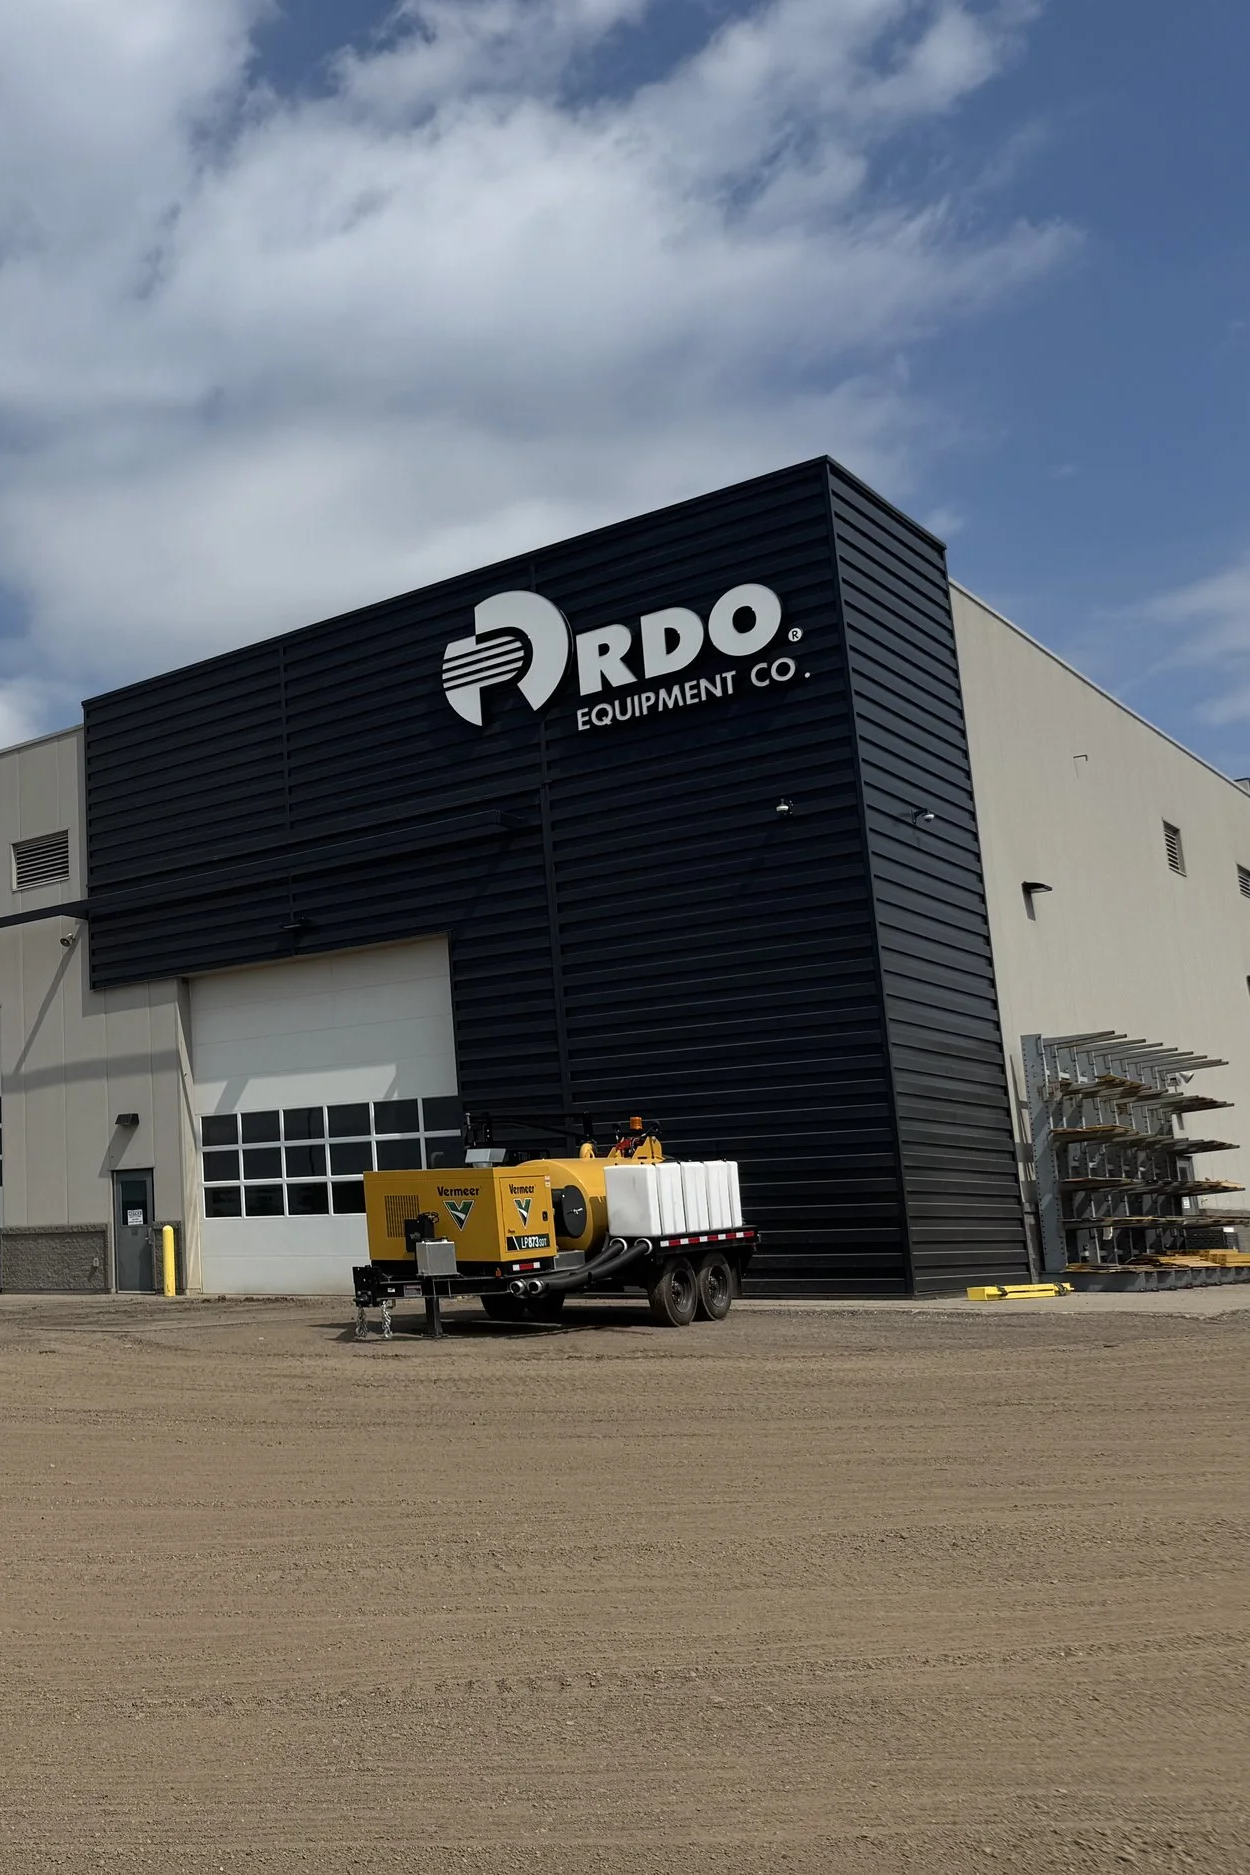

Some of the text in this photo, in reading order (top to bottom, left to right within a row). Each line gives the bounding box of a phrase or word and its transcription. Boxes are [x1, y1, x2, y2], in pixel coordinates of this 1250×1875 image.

[576, 657, 811, 731] EQUIPMENT CO.
[437, 1186, 480, 1197] Vermeer
[508, 1184, 535, 1195] Vermeer
